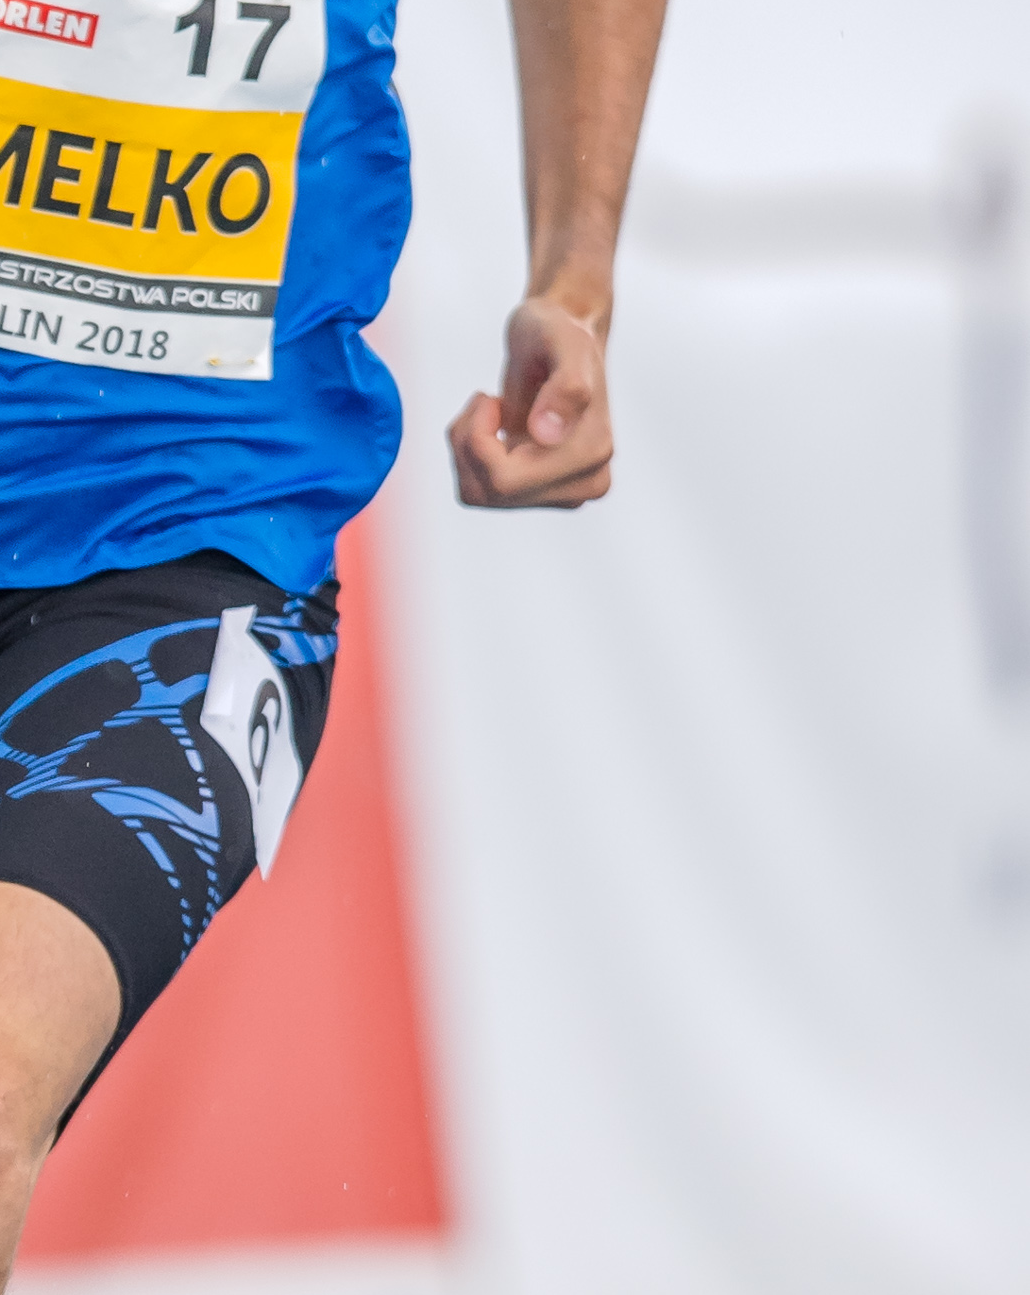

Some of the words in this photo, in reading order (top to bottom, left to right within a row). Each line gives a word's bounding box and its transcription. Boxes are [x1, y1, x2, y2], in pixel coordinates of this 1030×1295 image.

[170, 288, 260, 312] POLSKI
[76, 321, 170, 361] 2018
[248, 678, 282, 788] 6
